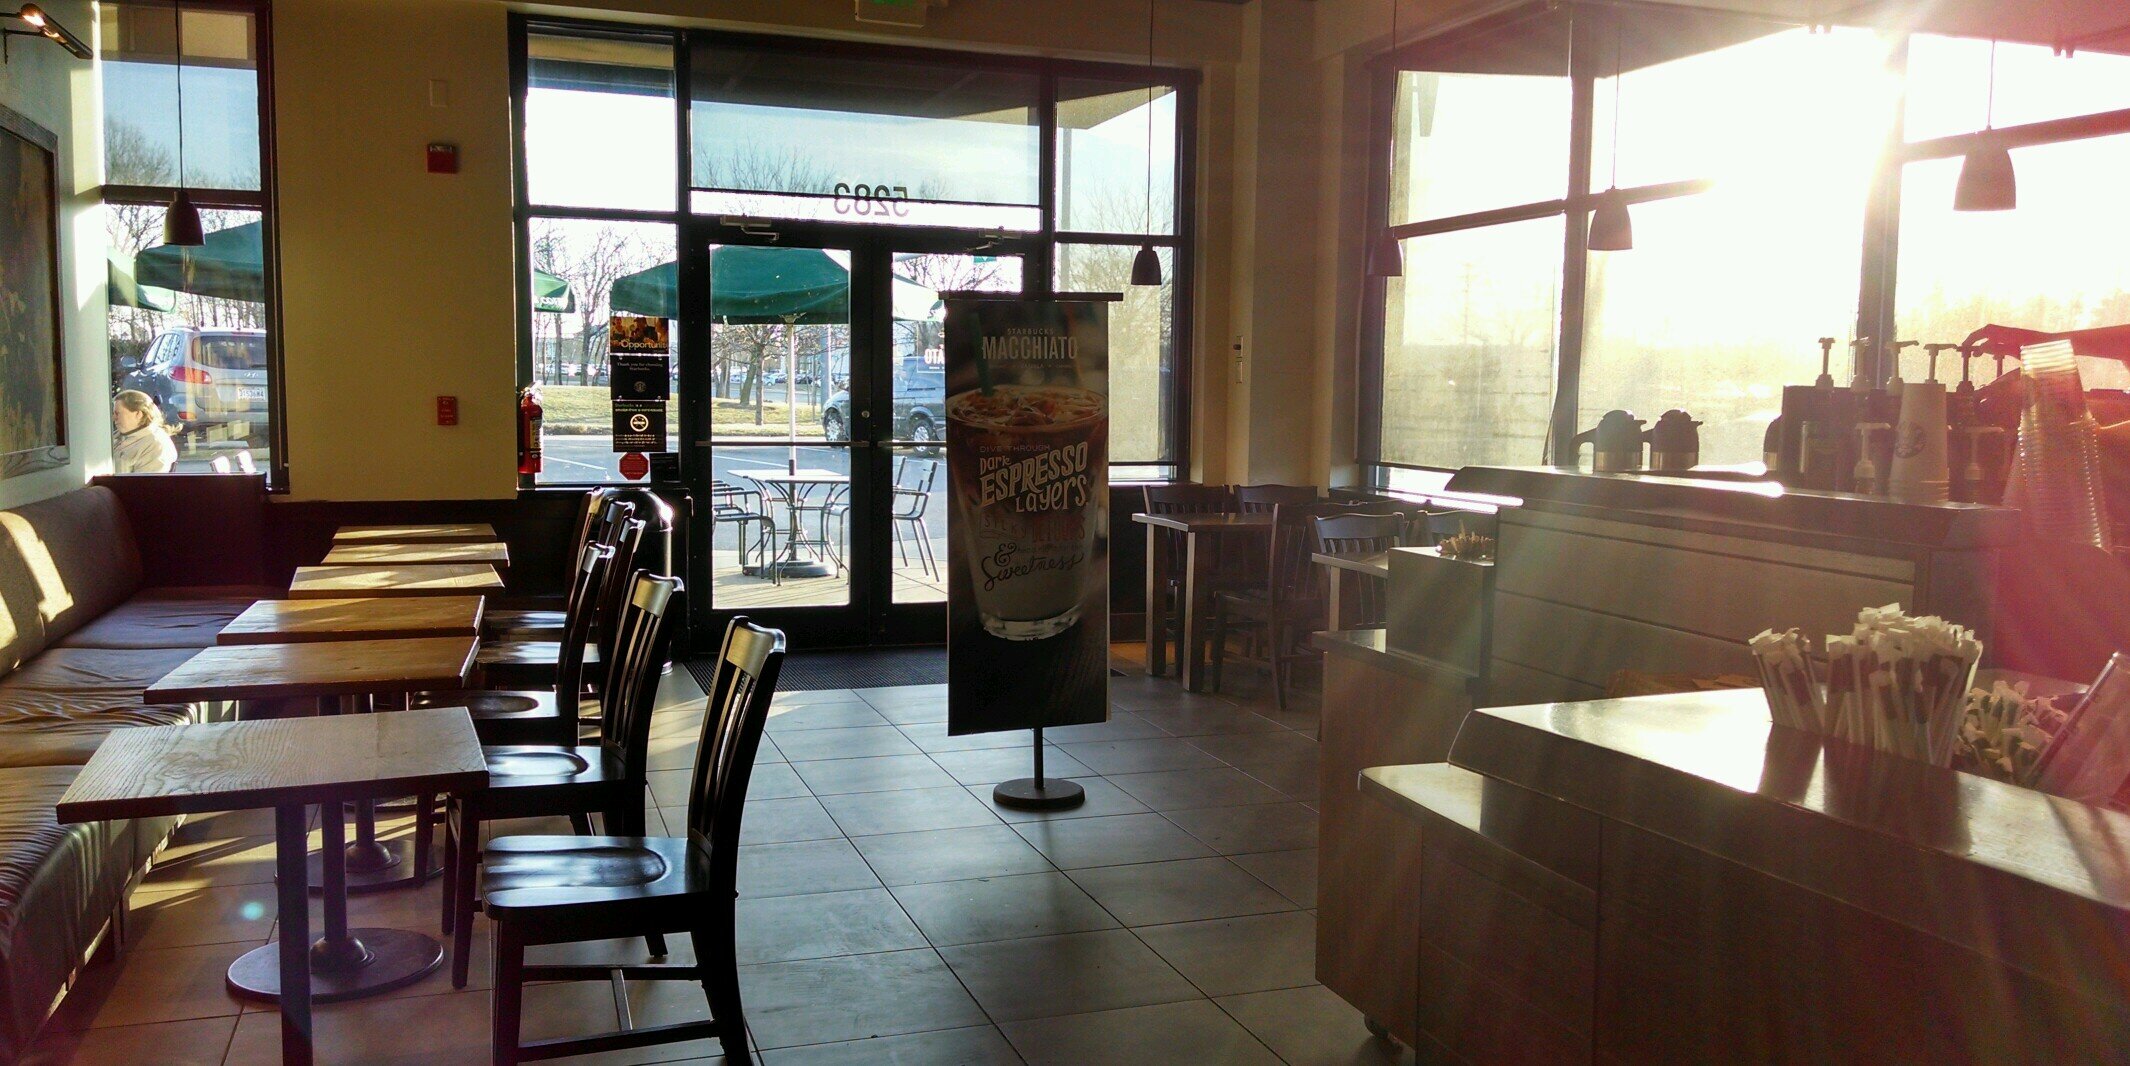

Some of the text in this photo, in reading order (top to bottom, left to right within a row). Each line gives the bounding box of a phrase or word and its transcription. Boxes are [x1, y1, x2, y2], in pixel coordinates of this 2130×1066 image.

[981, 336, 1078, 360] MACCHIATO
[1007, 444, 1050, 452] THROUGH
[979, 455, 1011, 475] Dark
[979, 441, 1088, 508] ESPRESSO
[1015, 474, 1088, 513] Layers
[994, 542, 1017, 567] &
[981, 553, 1084, 591] Sweetness
